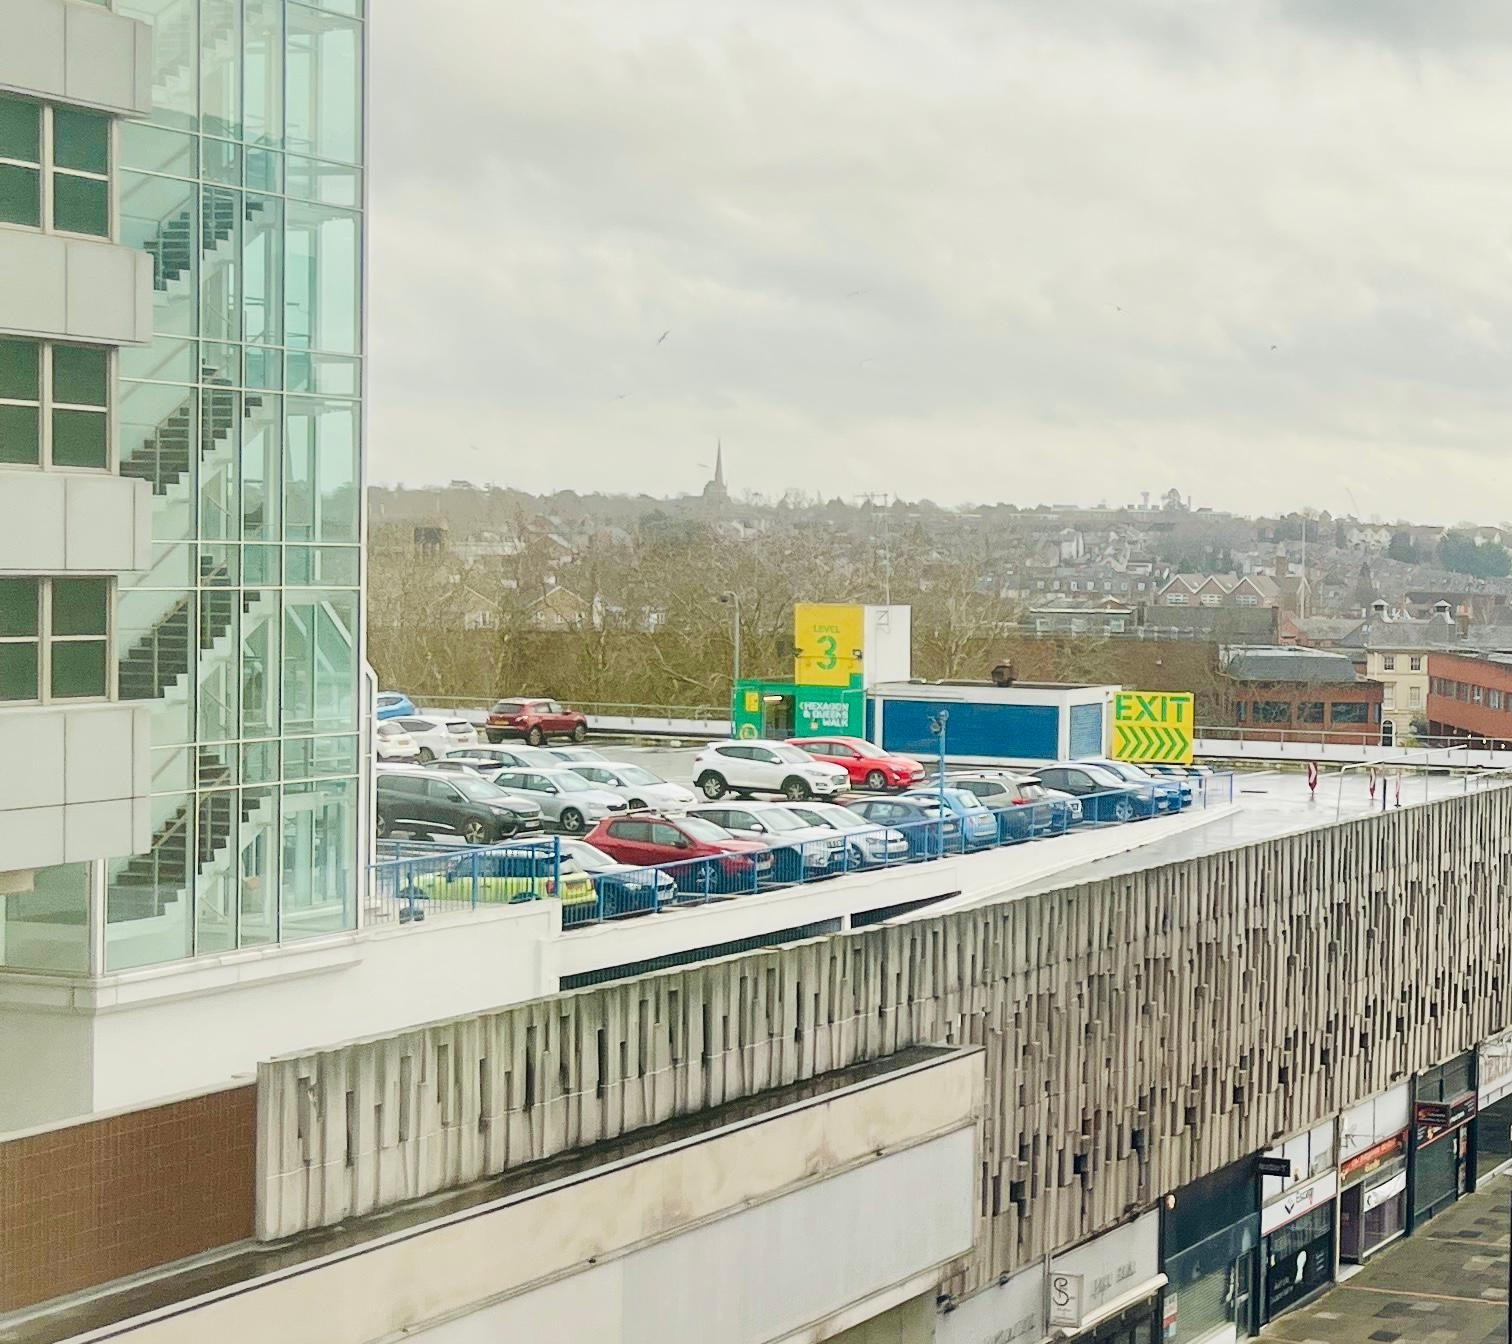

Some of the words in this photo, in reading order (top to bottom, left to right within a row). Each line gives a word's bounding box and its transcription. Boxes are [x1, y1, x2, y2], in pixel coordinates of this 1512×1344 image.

[813, 624, 841, 634] LEVEL
[816, 635, 837, 670] 3
[803, 701, 849, 711] HEXAGON
[1115, 694, 1191, 723] EXIT
[822, 718, 849, 728] WALK
